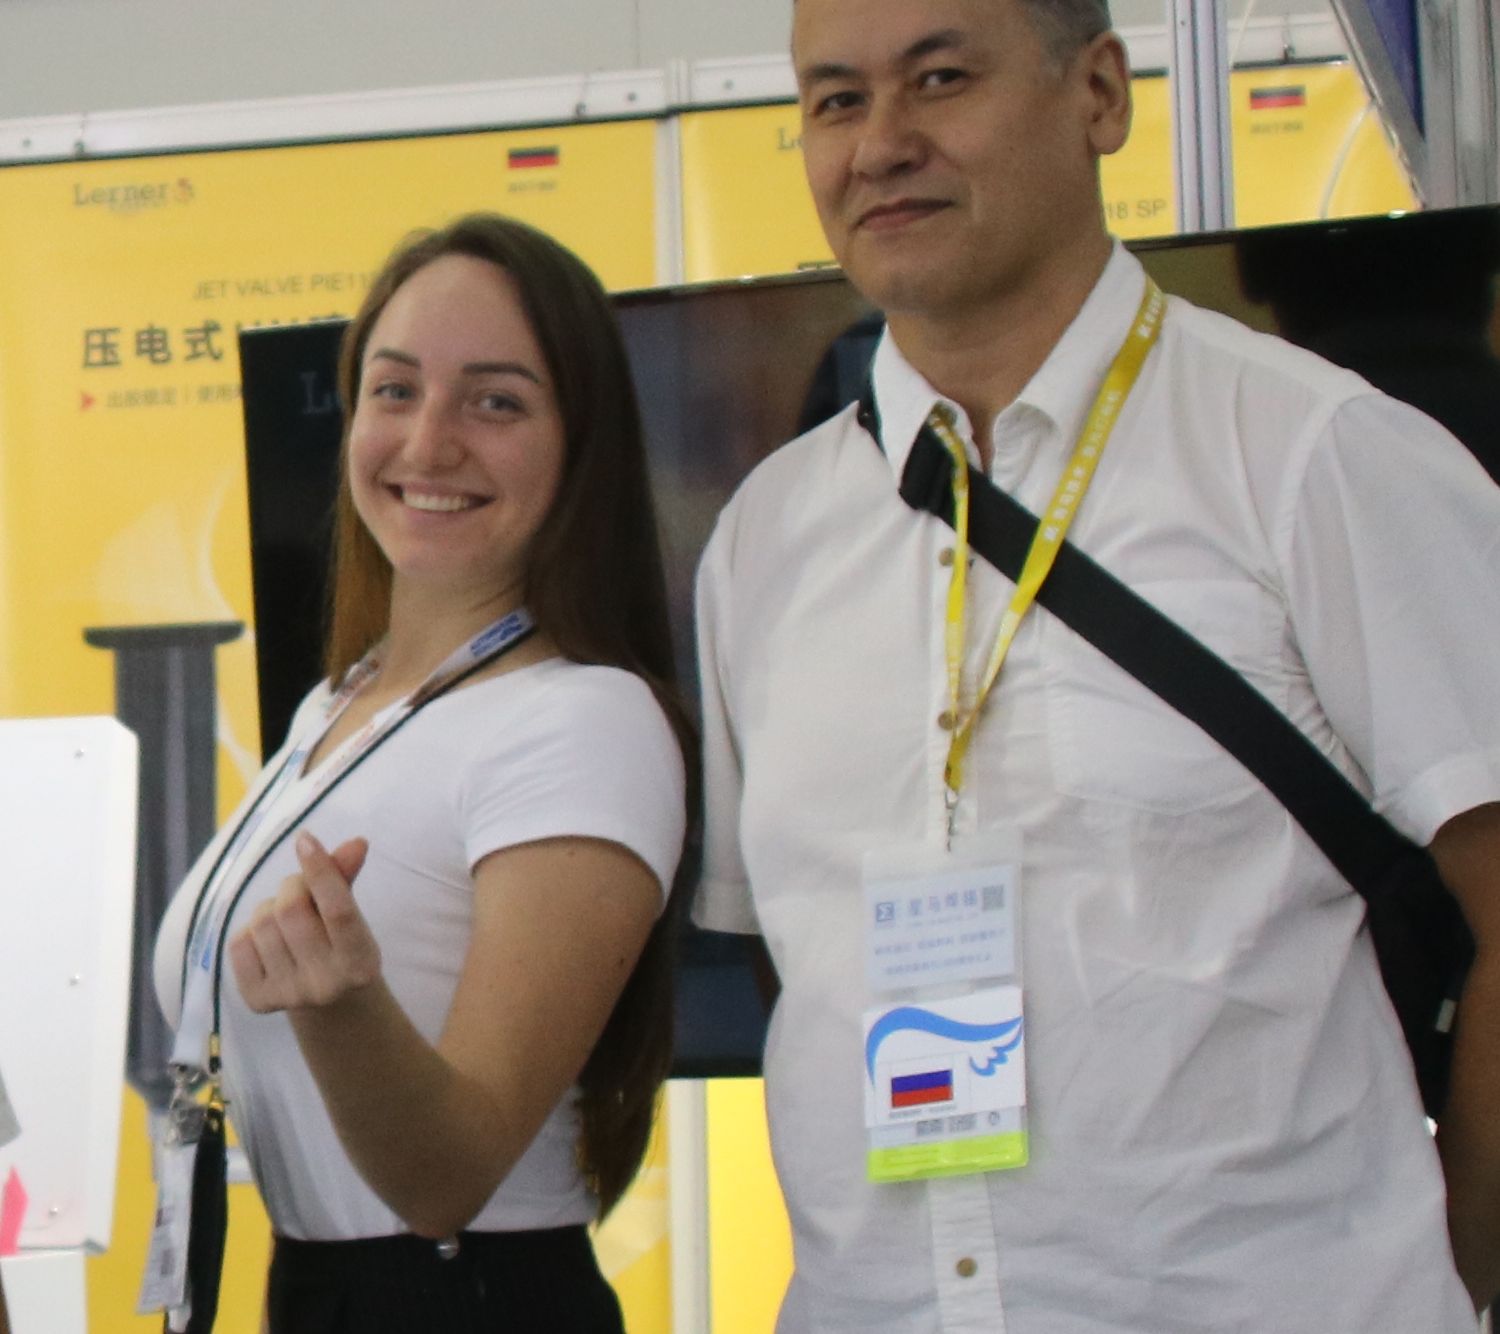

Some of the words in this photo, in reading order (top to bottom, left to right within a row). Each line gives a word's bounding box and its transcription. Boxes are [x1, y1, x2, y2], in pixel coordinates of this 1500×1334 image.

[237, 275, 305, 296] VALVE
[82, 318, 224, 370] 压电式
